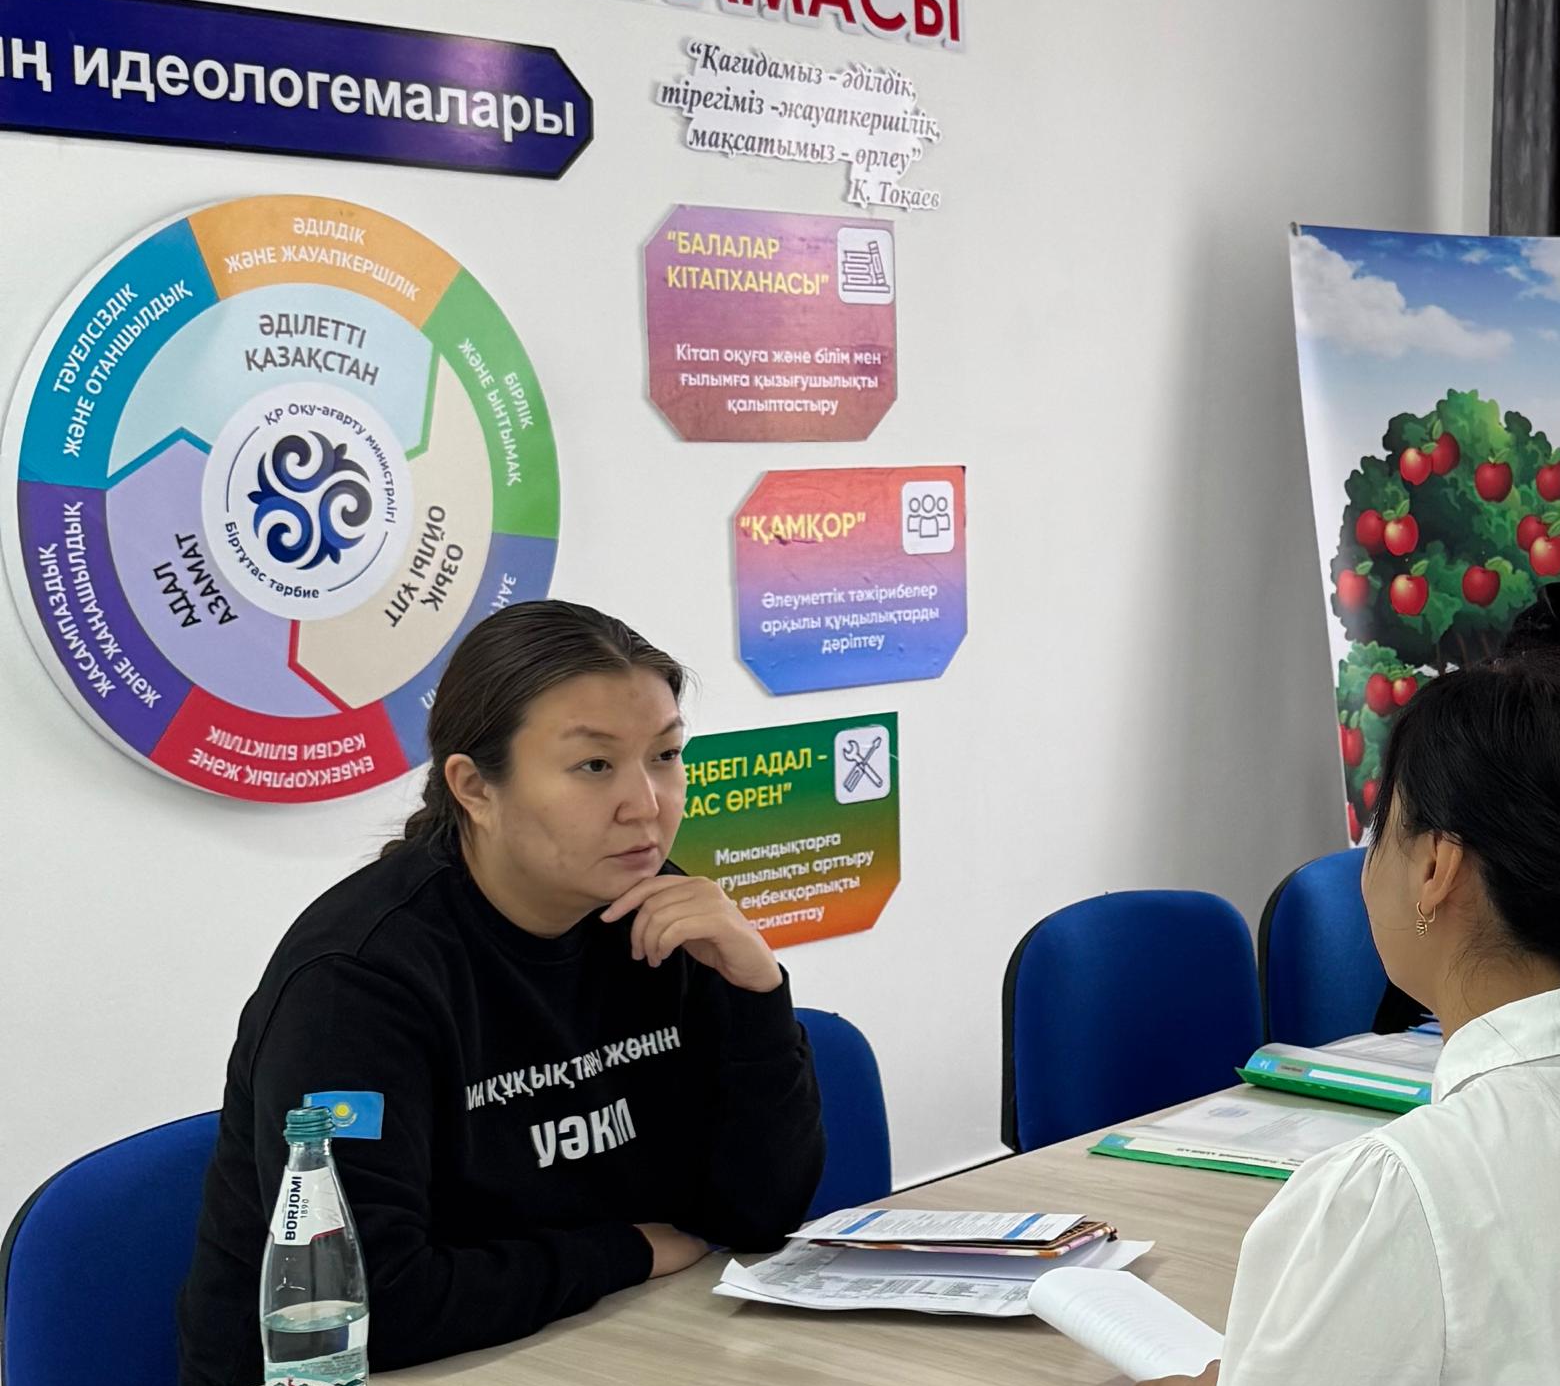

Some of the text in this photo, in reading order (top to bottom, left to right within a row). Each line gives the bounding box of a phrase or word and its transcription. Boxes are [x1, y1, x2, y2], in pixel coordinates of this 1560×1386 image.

[74, 44, 576, 142] идеологемалары
[661, 81, 765, 115] тірегіміз
[689, 128, 836, 160] мақсатымыз
[292, 217, 367, 246] ӘДІЛДІК
[224, 244, 421, 302] ЖӘНЕ ЖАУАПКЕРШІЛІК
[53, 283, 139, 393] ТӘУЕЛСІЗДІК
[259, 313, 367, 349] ӘДІЛЕТТІ
[63, 279, 193, 458] ЖӘНЕ ОТАНШЫЛДЫҚ
[244, 346, 379, 386] ҚАЗАҚСТАН
[676, 344, 881, 367] Кітап оқуға және білім мен
[504, 371, 534, 429] БІРЛІК
[681, 372, 878, 394] ғылымға қызығушылықты
[458, 338, 522, 487] ЖӘНЕ ЫНТЫМАҚ
[728, 397, 839, 416] қалыптастыру
[175, 533, 239, 626] АЗАМАТ
[384, 505, 446, 629] ОЙЛЫ ҰЛТ
[421, 544, 464, 612] ОЗЫҚ
[63, 501, 162, 708] ЖӘНЕ ЖАҢАШЫЛДЫҚ
[153, 562, 202, 628] АДАЛ
[269, 578, 320, 599] тәрбие
[762, 582, 939, 610] Әлеуметтік тәжірибелер
[38, 543, 116, 698] ЖАСАМПАЗДЫҚ
[761, 607, 940, 634] арқылы құндылықтарды
[822, 633, 885, 655] дәріптеу
[205, 725, 366, 761] КӘСІБИ БІЛІКТІЛІК
[753, 747, 812, 778] АДАЛ
[188, 747, 375, 788] ЕҢБЕКҚОРЛЫҚ ЖӘНЕ
[715, 833, 841, 866] Мамандықтарға
[812, 849, 874, 875] арттыру
[529, 1097, 638, 1169] УӘКІЛ
[285, 1175, 302, 1241] BORJOMI
